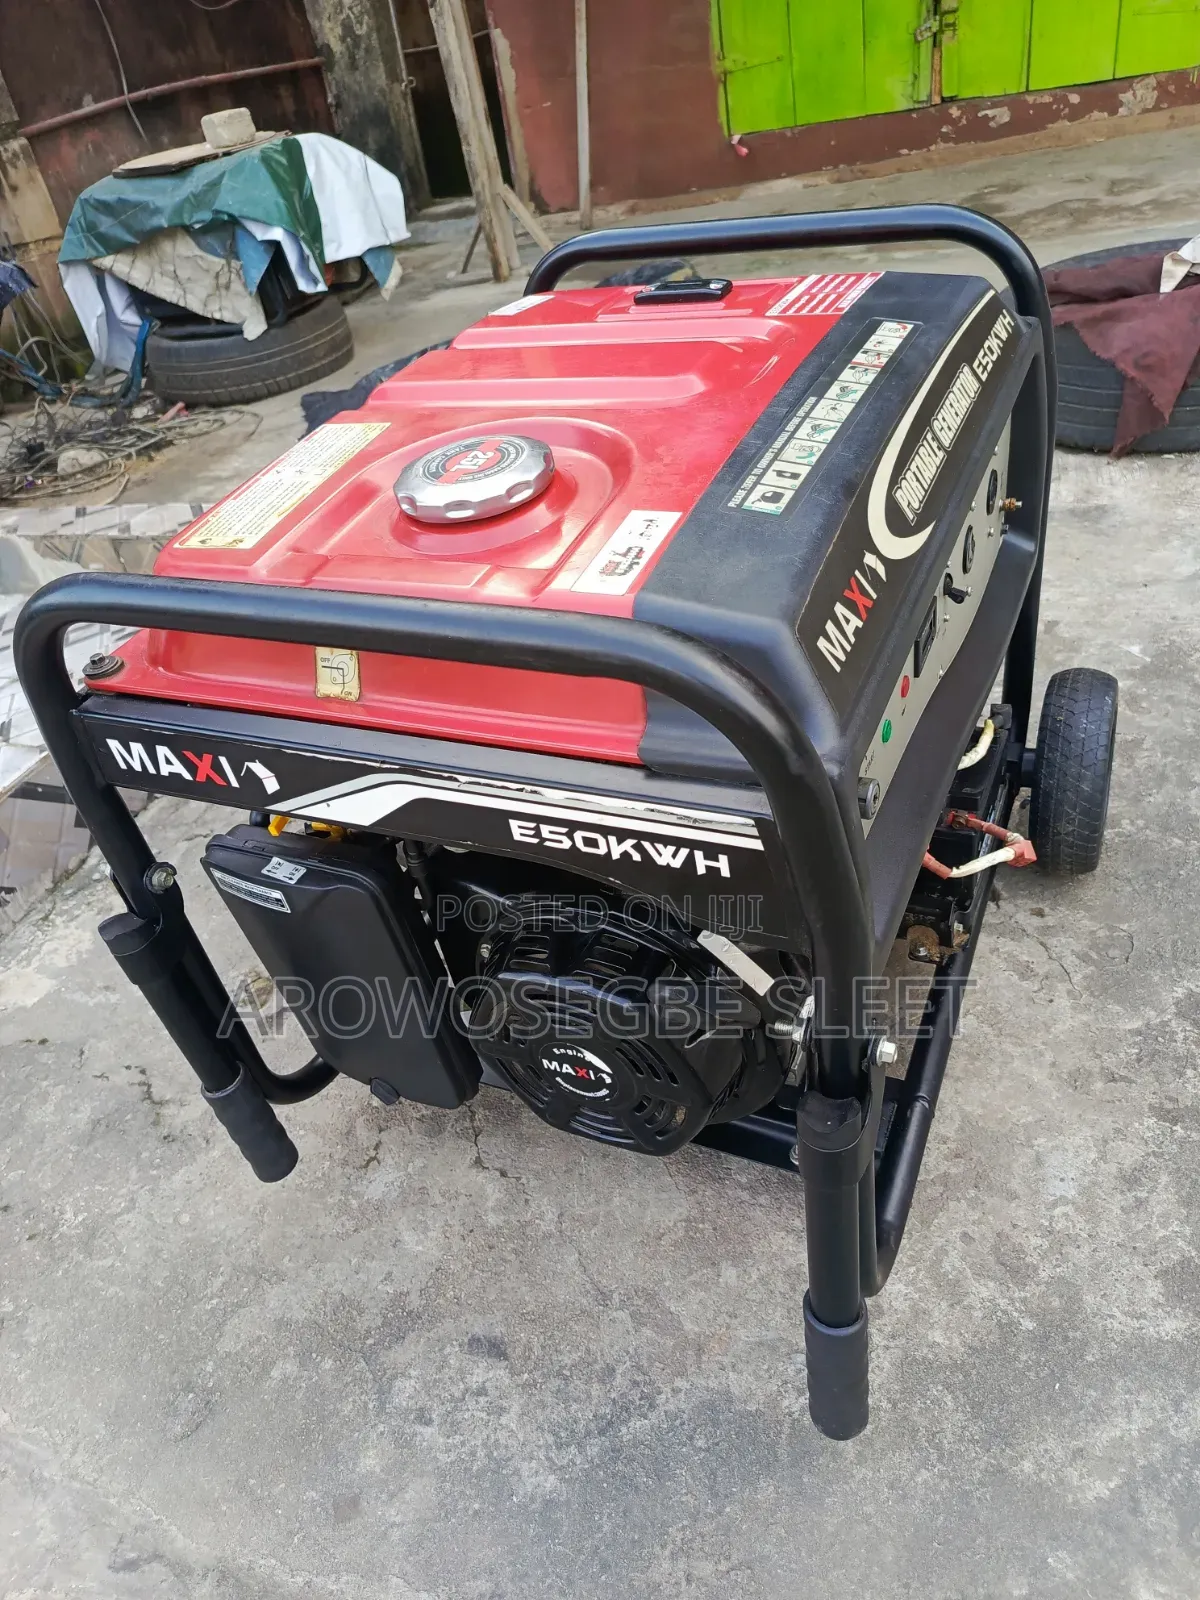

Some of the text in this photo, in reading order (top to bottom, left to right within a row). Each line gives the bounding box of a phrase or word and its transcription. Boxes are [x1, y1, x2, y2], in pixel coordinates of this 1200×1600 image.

[892, 309, 1014, 525] PORTABLE GENERATOR E50KWH
[450, 450, 495, 472] 25L
[727, 489, 748, 508] PLEASE
[816, 568, 877, 674] MAXI
[105, 738, 240, 788] MAXI
[508, 818, 731, 878] E50KWH
[541, 1058, 596, 1081] MAXI
